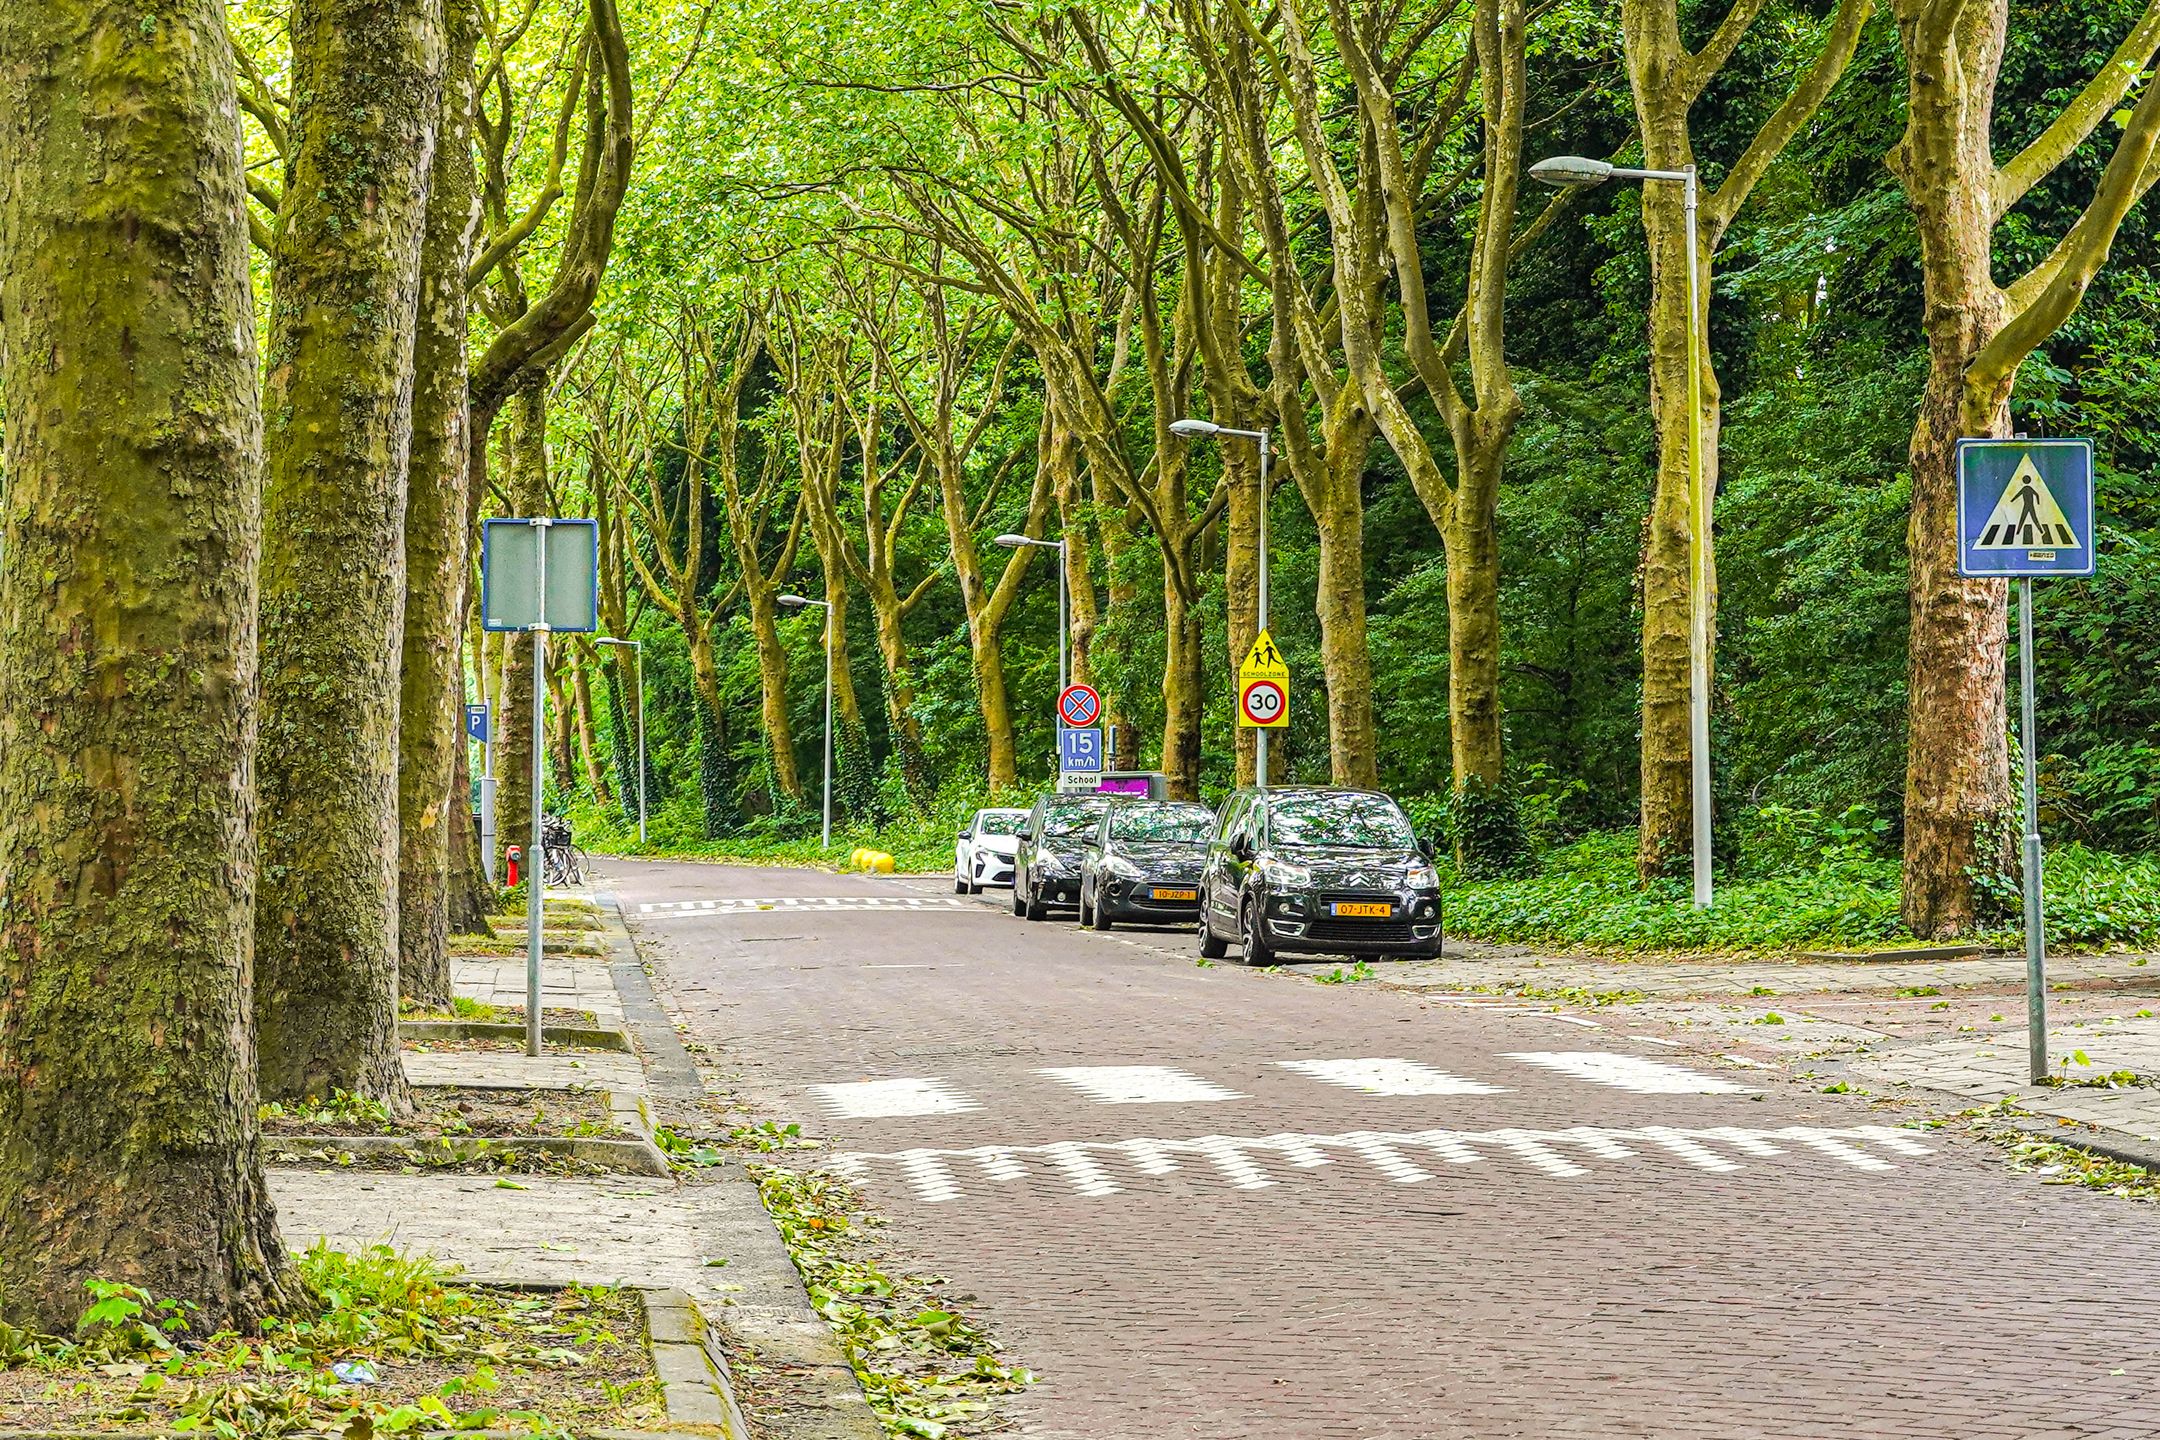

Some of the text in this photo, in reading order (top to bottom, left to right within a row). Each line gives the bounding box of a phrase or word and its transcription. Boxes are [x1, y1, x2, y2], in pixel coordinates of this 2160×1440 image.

[1250, 693, 1278, 710] 30
[472, 716, 480, 730] P
[1069, 732, 1093, 754] 15
[1067, 756, 1096, 768] km/h
[1067, 775, 1097, 784] School
[1340, 904, 1386, 915] 07-JTK-4
